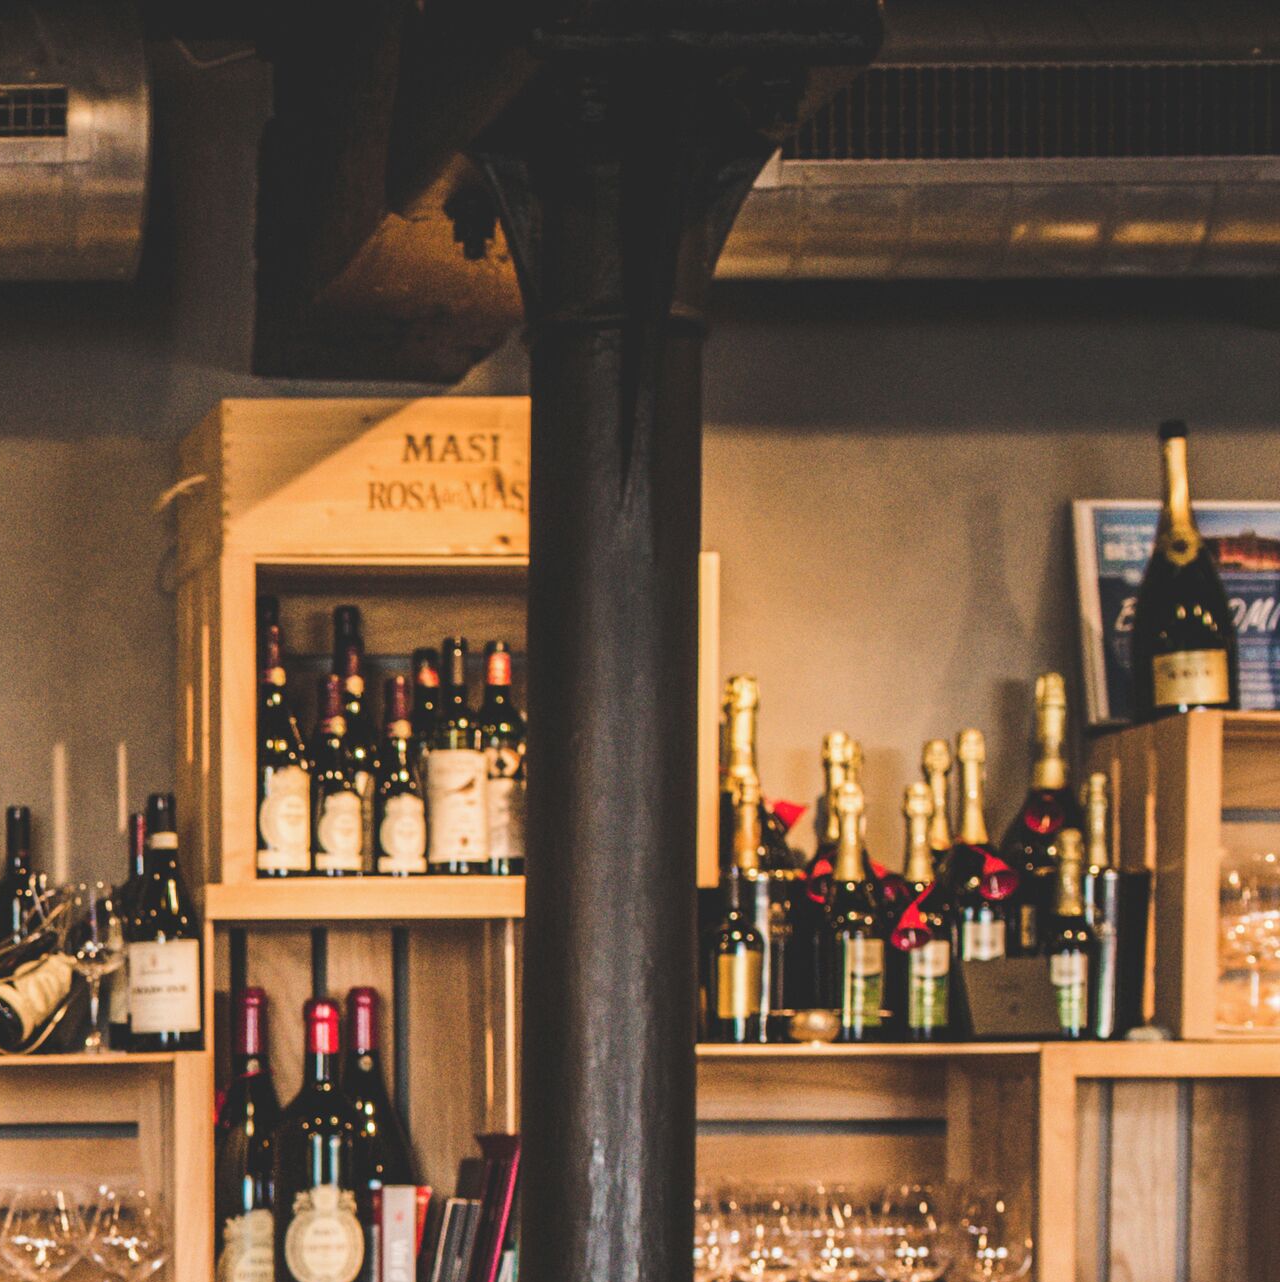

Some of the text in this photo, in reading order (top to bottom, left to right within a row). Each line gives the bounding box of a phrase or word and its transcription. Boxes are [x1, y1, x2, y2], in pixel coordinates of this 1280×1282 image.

[402, 433, 500, 463] MASI
[367, 480, 442, 513] ROSA
[464, 480, 528, 514] MAS
